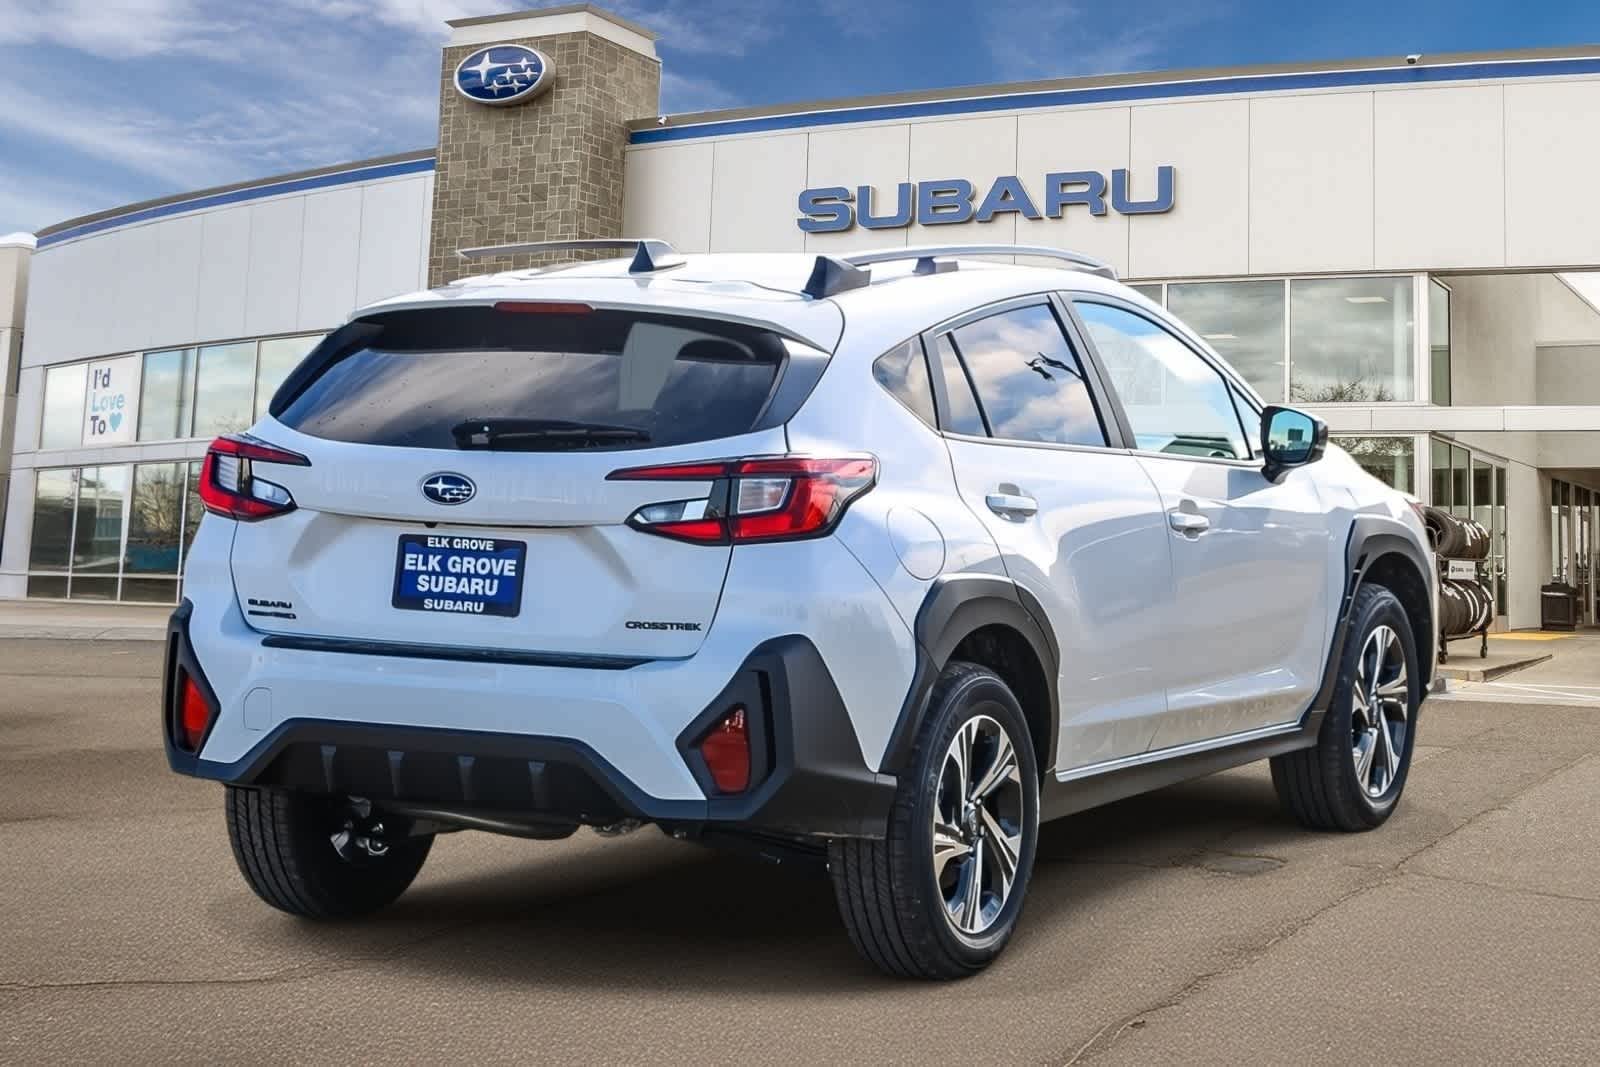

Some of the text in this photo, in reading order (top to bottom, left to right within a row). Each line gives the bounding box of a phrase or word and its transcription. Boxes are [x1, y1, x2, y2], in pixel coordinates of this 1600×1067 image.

[797, 165, 1176, 234] SUBARU
[93, 367, 111, 390] I'd
[91, 391, 126, 412] Love
[90, 415, 107, 436] To
[427, 536, 495, 551] ELK GROVE
[404, 553, 517, 577] ELK GROVE
[416, 574, 499, 597] SUBARU
[423, 598, 485, 613] SUBARU
[625, 621, 702, 632] CROSSTREK
